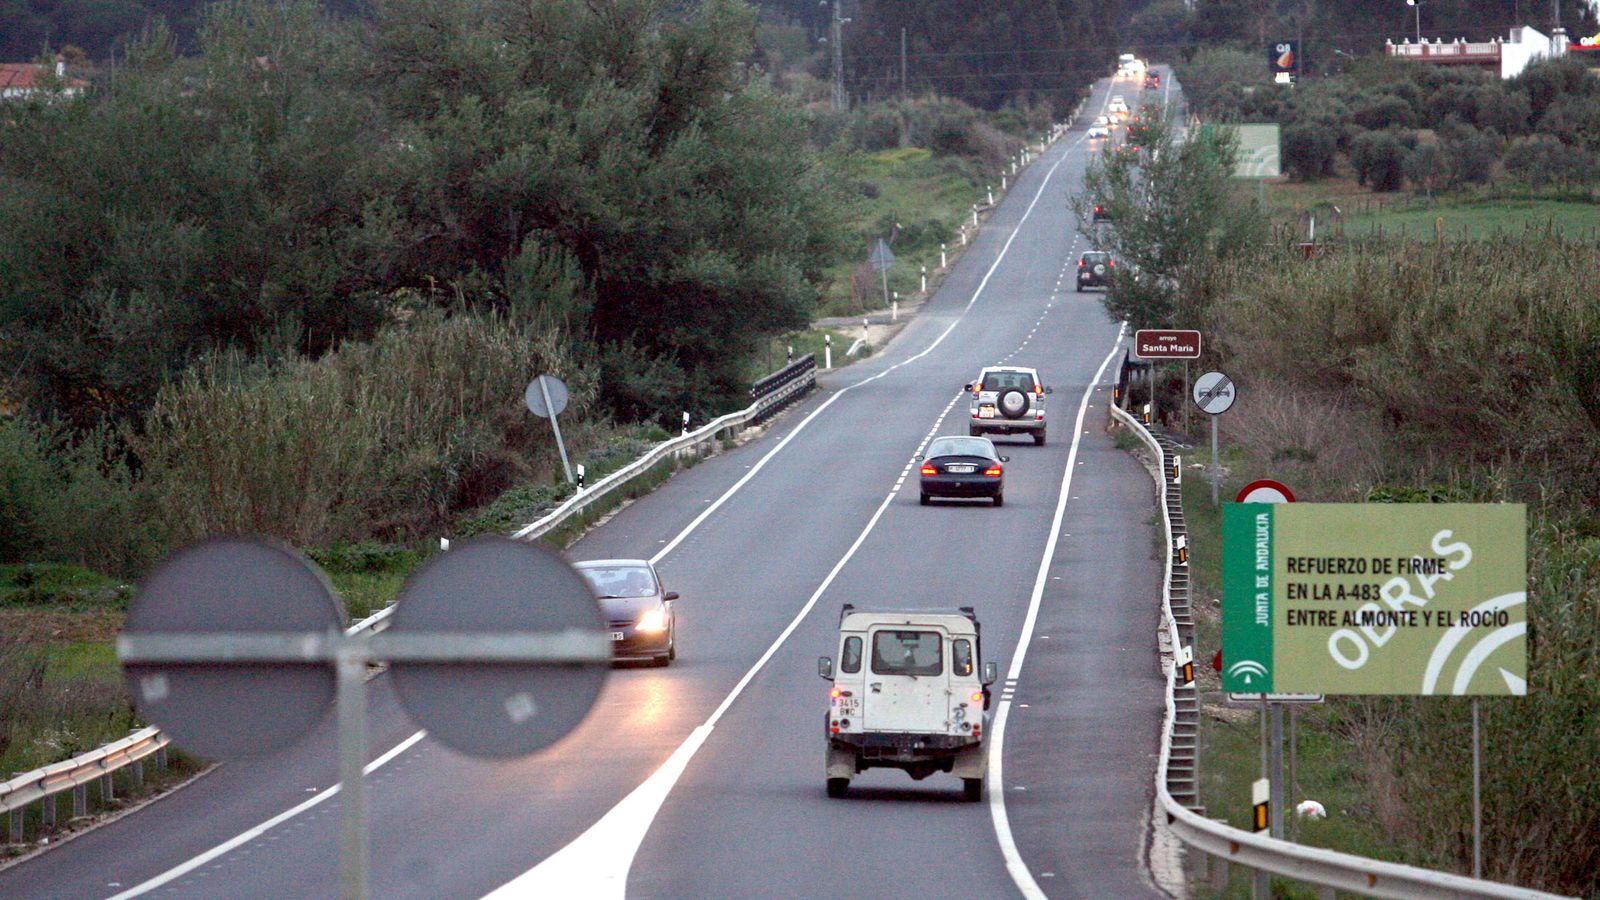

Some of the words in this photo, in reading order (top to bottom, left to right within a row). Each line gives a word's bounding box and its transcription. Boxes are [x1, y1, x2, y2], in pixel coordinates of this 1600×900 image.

[1142, 344, 1168, 352] Santa
[1287, 557, 1367, 574] REFUERZO
[1371, 557, 1393, 574] DE
[1397, 557, 1447, 574] FIRME
[1256, 575, 1269, 588] DE
[1287, 583, 1308, 600] EN
[1313, 583, 1332, 600] LA
[1336, 583, 1381, 600] A-483
[1328, 529, 1473, 670] OBRAS
[1256, 592, 1269, 627] JUNTA
[1287, 609, 1338, 626] ENTRE
[1342, 609, 1418, 627] ALMONTE
[1422, 609, 1433, 626] Y
[1437, 609, 1456, 627] EL
[1460, 606, 1509, 627] ROCÍO
[839, 699, 860, 708] 3415
